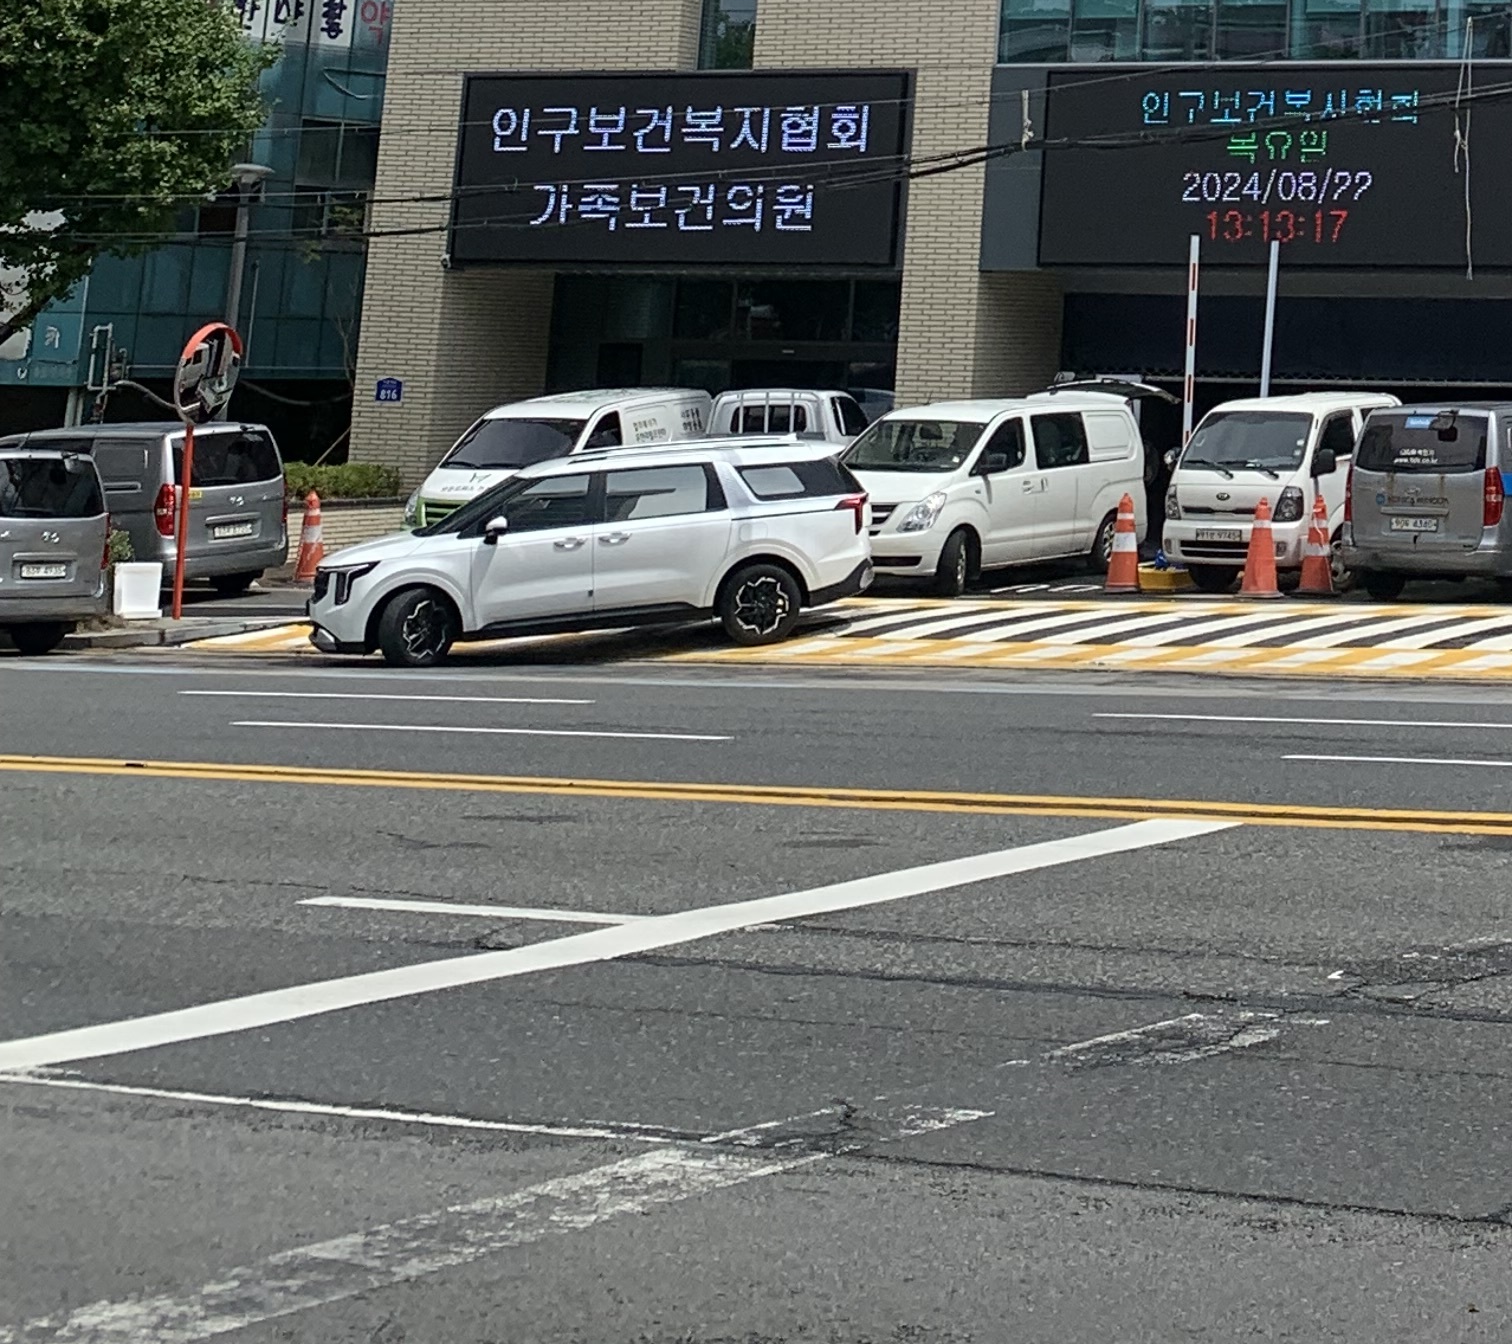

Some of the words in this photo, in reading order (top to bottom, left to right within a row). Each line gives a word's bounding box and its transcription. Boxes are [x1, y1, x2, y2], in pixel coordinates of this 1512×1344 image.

[491, 104, 870, 154] 인구보건복지협회
[528, 182, 815, 233] 가족보건의원
[1205, 208, 1350, 244] 13:13:17
[379, 388, 398, 401] 816
